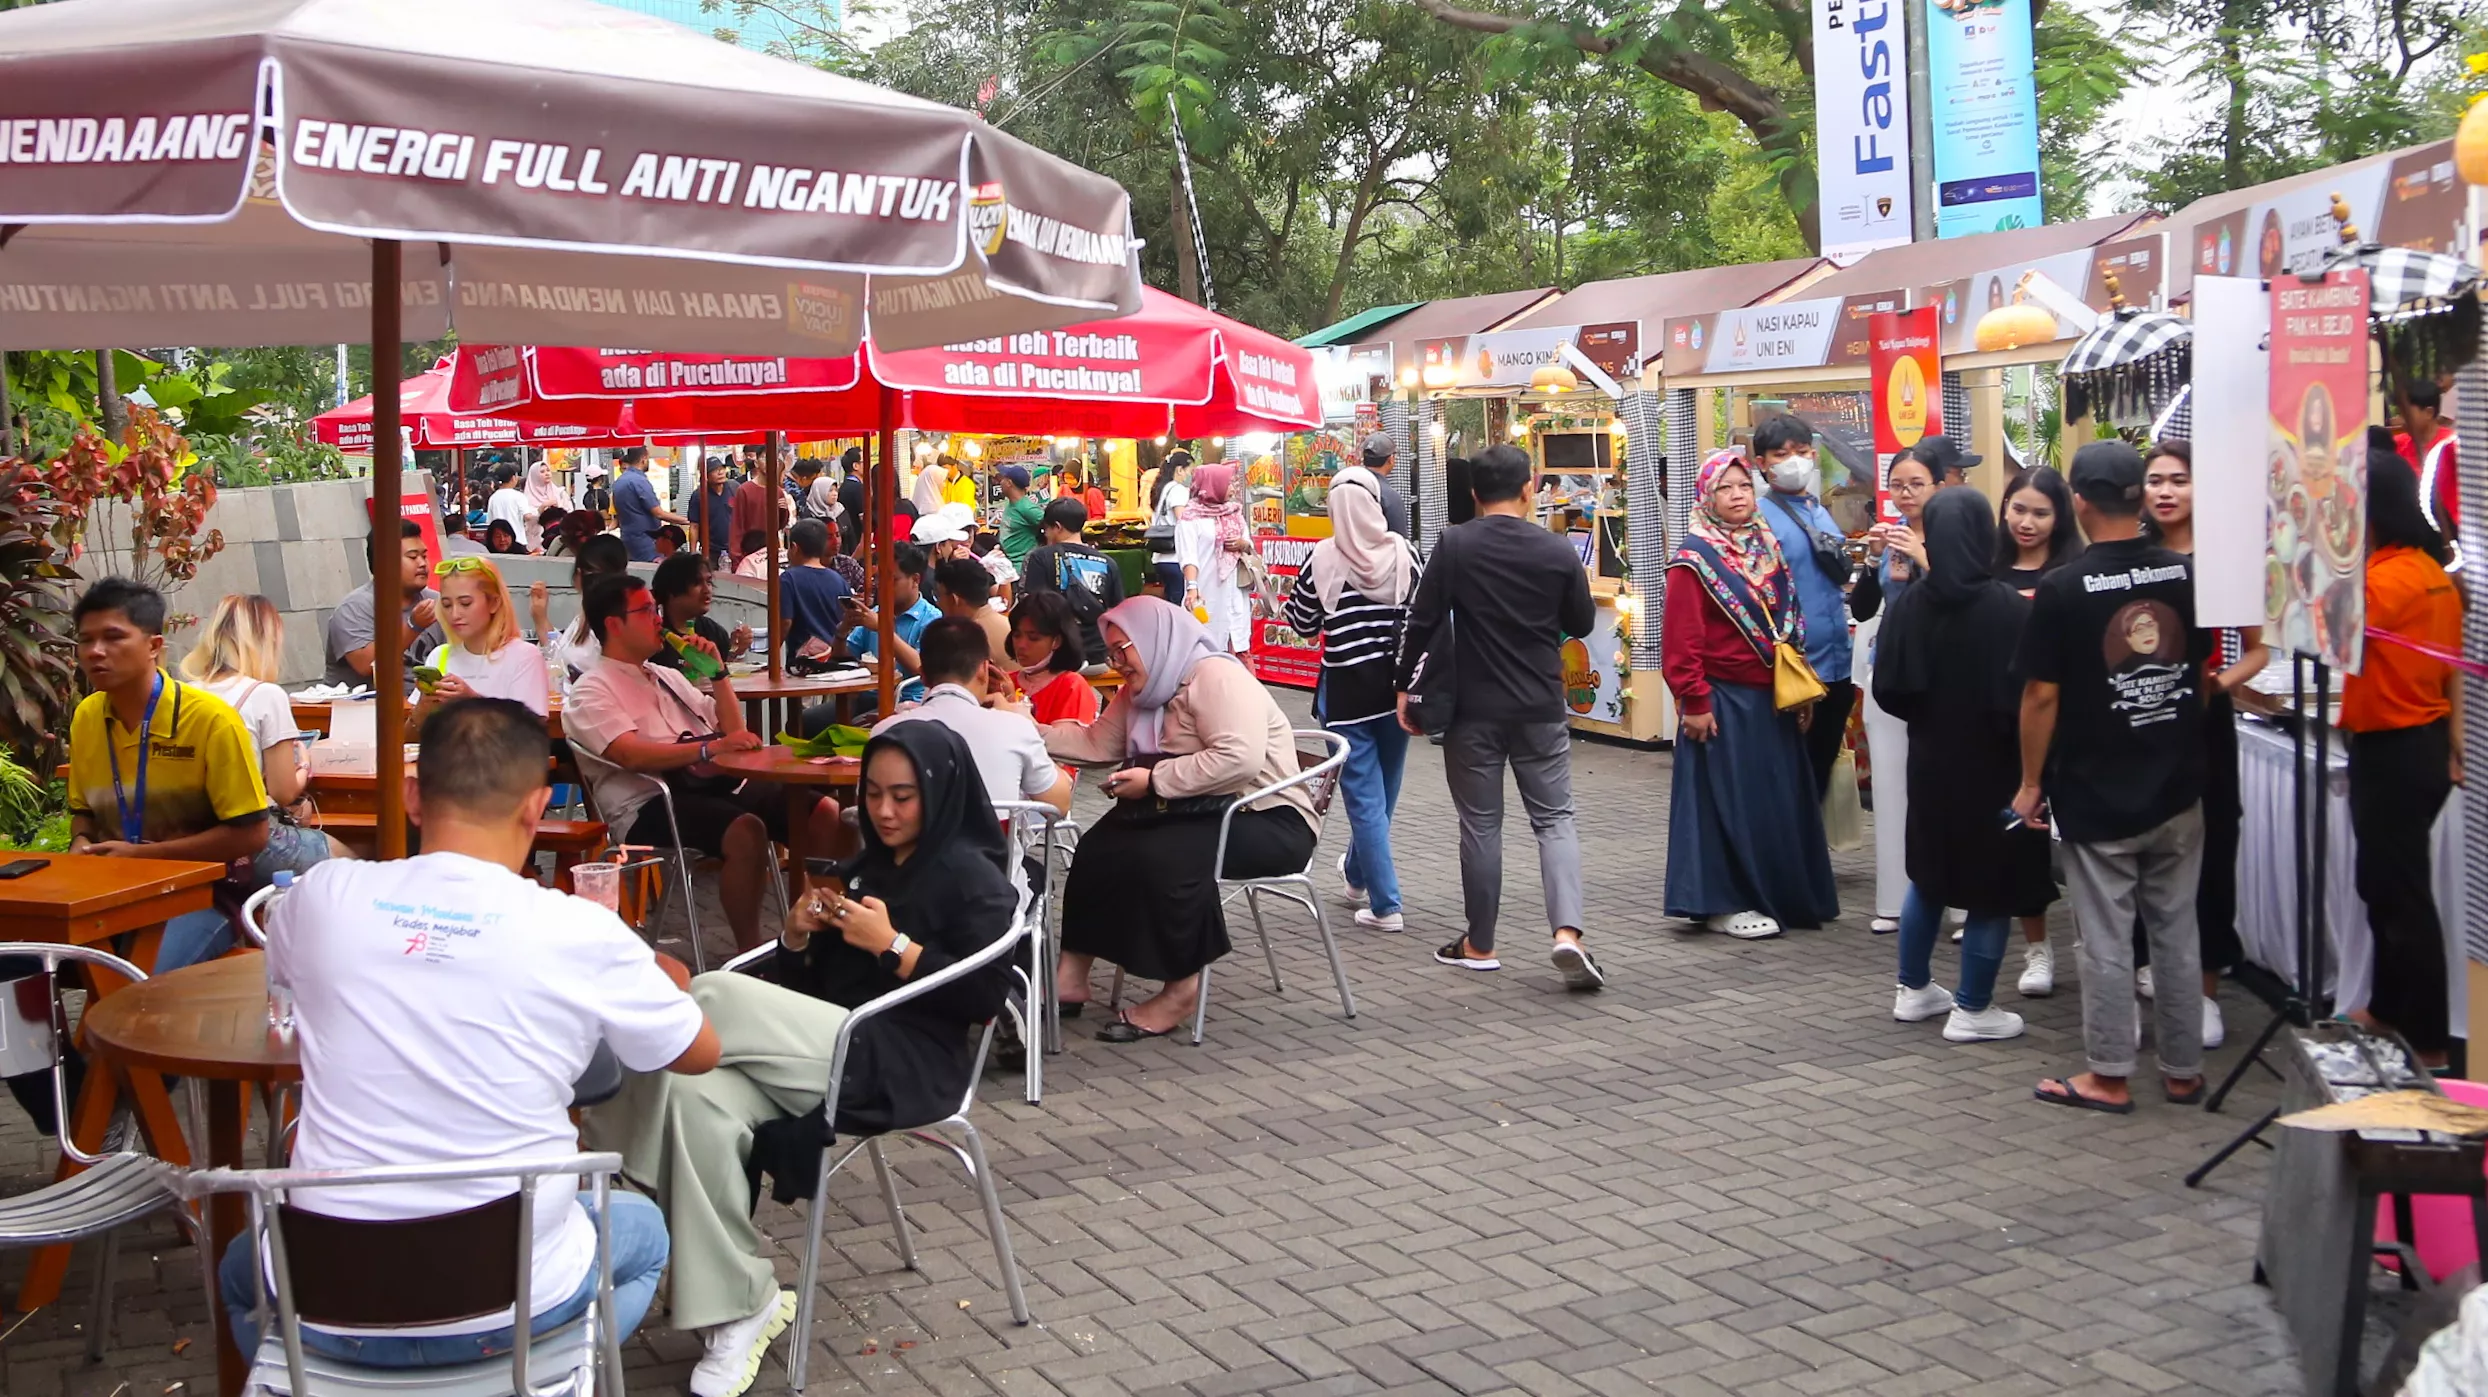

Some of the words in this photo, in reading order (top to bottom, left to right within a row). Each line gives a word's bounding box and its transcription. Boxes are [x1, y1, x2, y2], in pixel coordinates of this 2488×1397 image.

[1828, 0, 1844, 29] PE
[1852, 0, 1894, 175] Fast
[292, 119, 474, 181] ENERGI
[482, 138, 609, 195] FULL
[621, 153, 742, 204] ANTI
[743, 164, 957, 222] NGANTUK
[2279, 289, 2308, 310] SATE
[2308, 285, 2361, 309] KAMBING
[1756, 314, 1780, 334] NASI
[1783, 311, 1820, 331] KAPAU
[2285, 316, 2308, 336] PAK
[2322, 314, 2354, 336] BEJO
[1051, 330, 1140, 362] Terbaik
[1756, 342, 1775, 357] UNI
[1777, 340, 1795, 355] ENI
[1239, 349, 1259, 377] Rasa
[1497, 351, 1534, 367] MANGO
[602, 364, 642, 389] ada
[645, 362, 667, 388] di
[670, 357, 787, 388] Pucuknya!
[944, 361, 989, 387] ada
[994, 362, 1017, 388] di
[1020, 363, 1142, 394] Pucuknya!
[338, 423, 356, 433] Rasa
[357, 422, 371, 433] Teh
[453, 419, 476, 429] Rasa
[476, 418, 492, 428] Teh
[454, 431, 472, 441] ada
[472, 430, 481, 440] di
[405, 503, 430, 516] PARKING
[1253, 506, 1283, 523] SALERO
[2082, 572, 2132, 593] Cabang
[2129, 564, 2188, 586] Bekonang
[1567, 670, 1601, 689] ANGO
[2115, 680, 2137, 692] SATE
[2123, 687, 2142, 698] PAK
[2138, 692, 2165, 704] SOLO
[152, 742, 195, 759] Prestone
